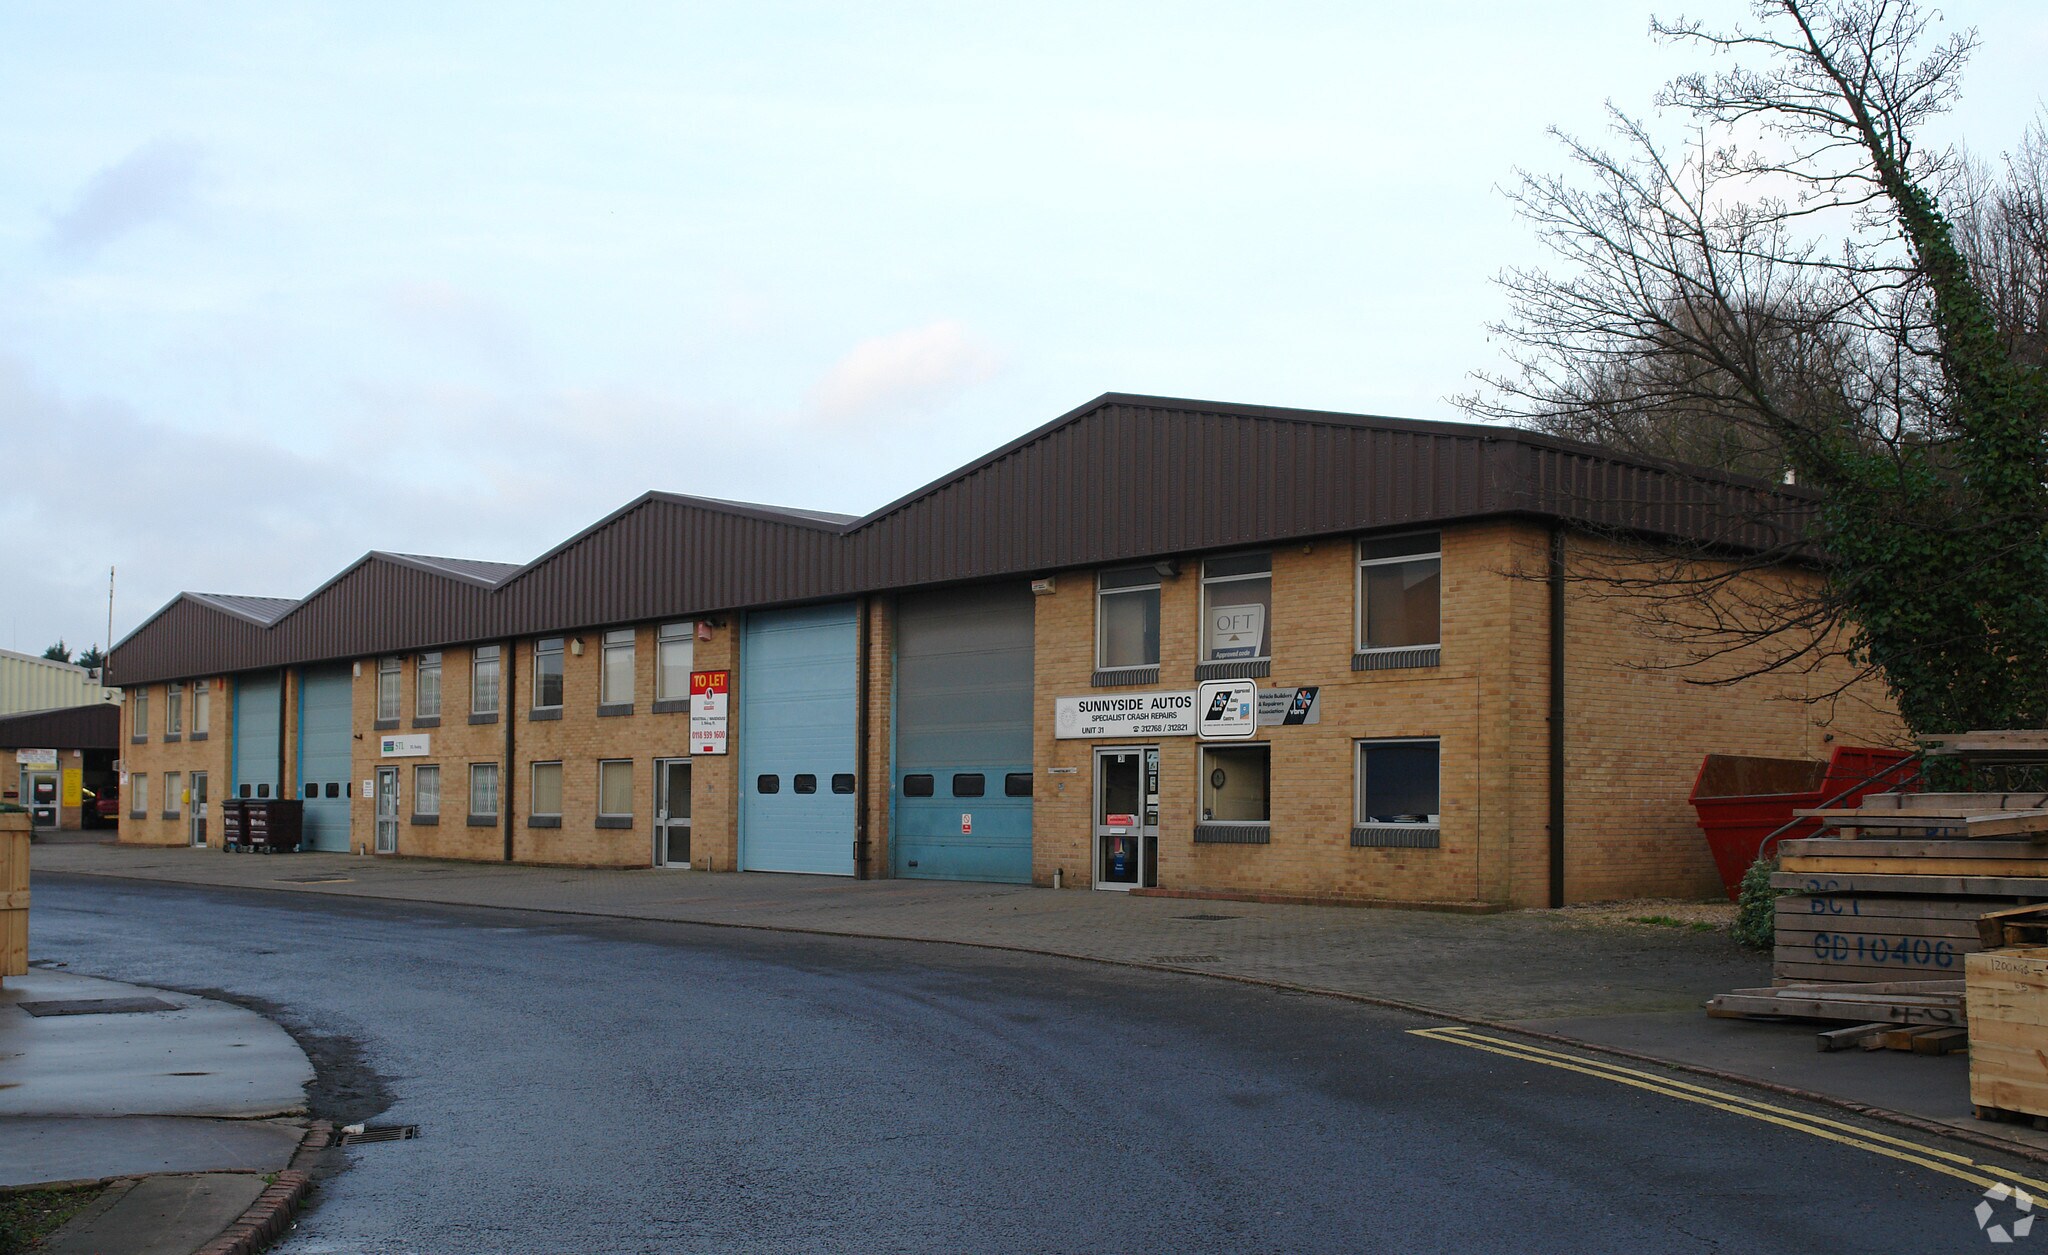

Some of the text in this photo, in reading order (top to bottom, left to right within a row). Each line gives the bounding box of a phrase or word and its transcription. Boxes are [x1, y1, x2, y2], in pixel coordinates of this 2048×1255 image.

[1217, 614, 1254, 631] OFT
[1216, 650, 1239, 659] Approved
[694, 674, 725, 687] TO LET
[1079, 696, 1192, 713] SUNNYSIDE AUTOS
[1092, 711, 1177, 722] SPECIALIST CRASH REPAIRS
[1141, 724, 1162, 732] 312768
[1167, 723, 1188, 732] 312821
[692, 731, 702, 739] 0118
[714, 730, 725, 739] 1600
